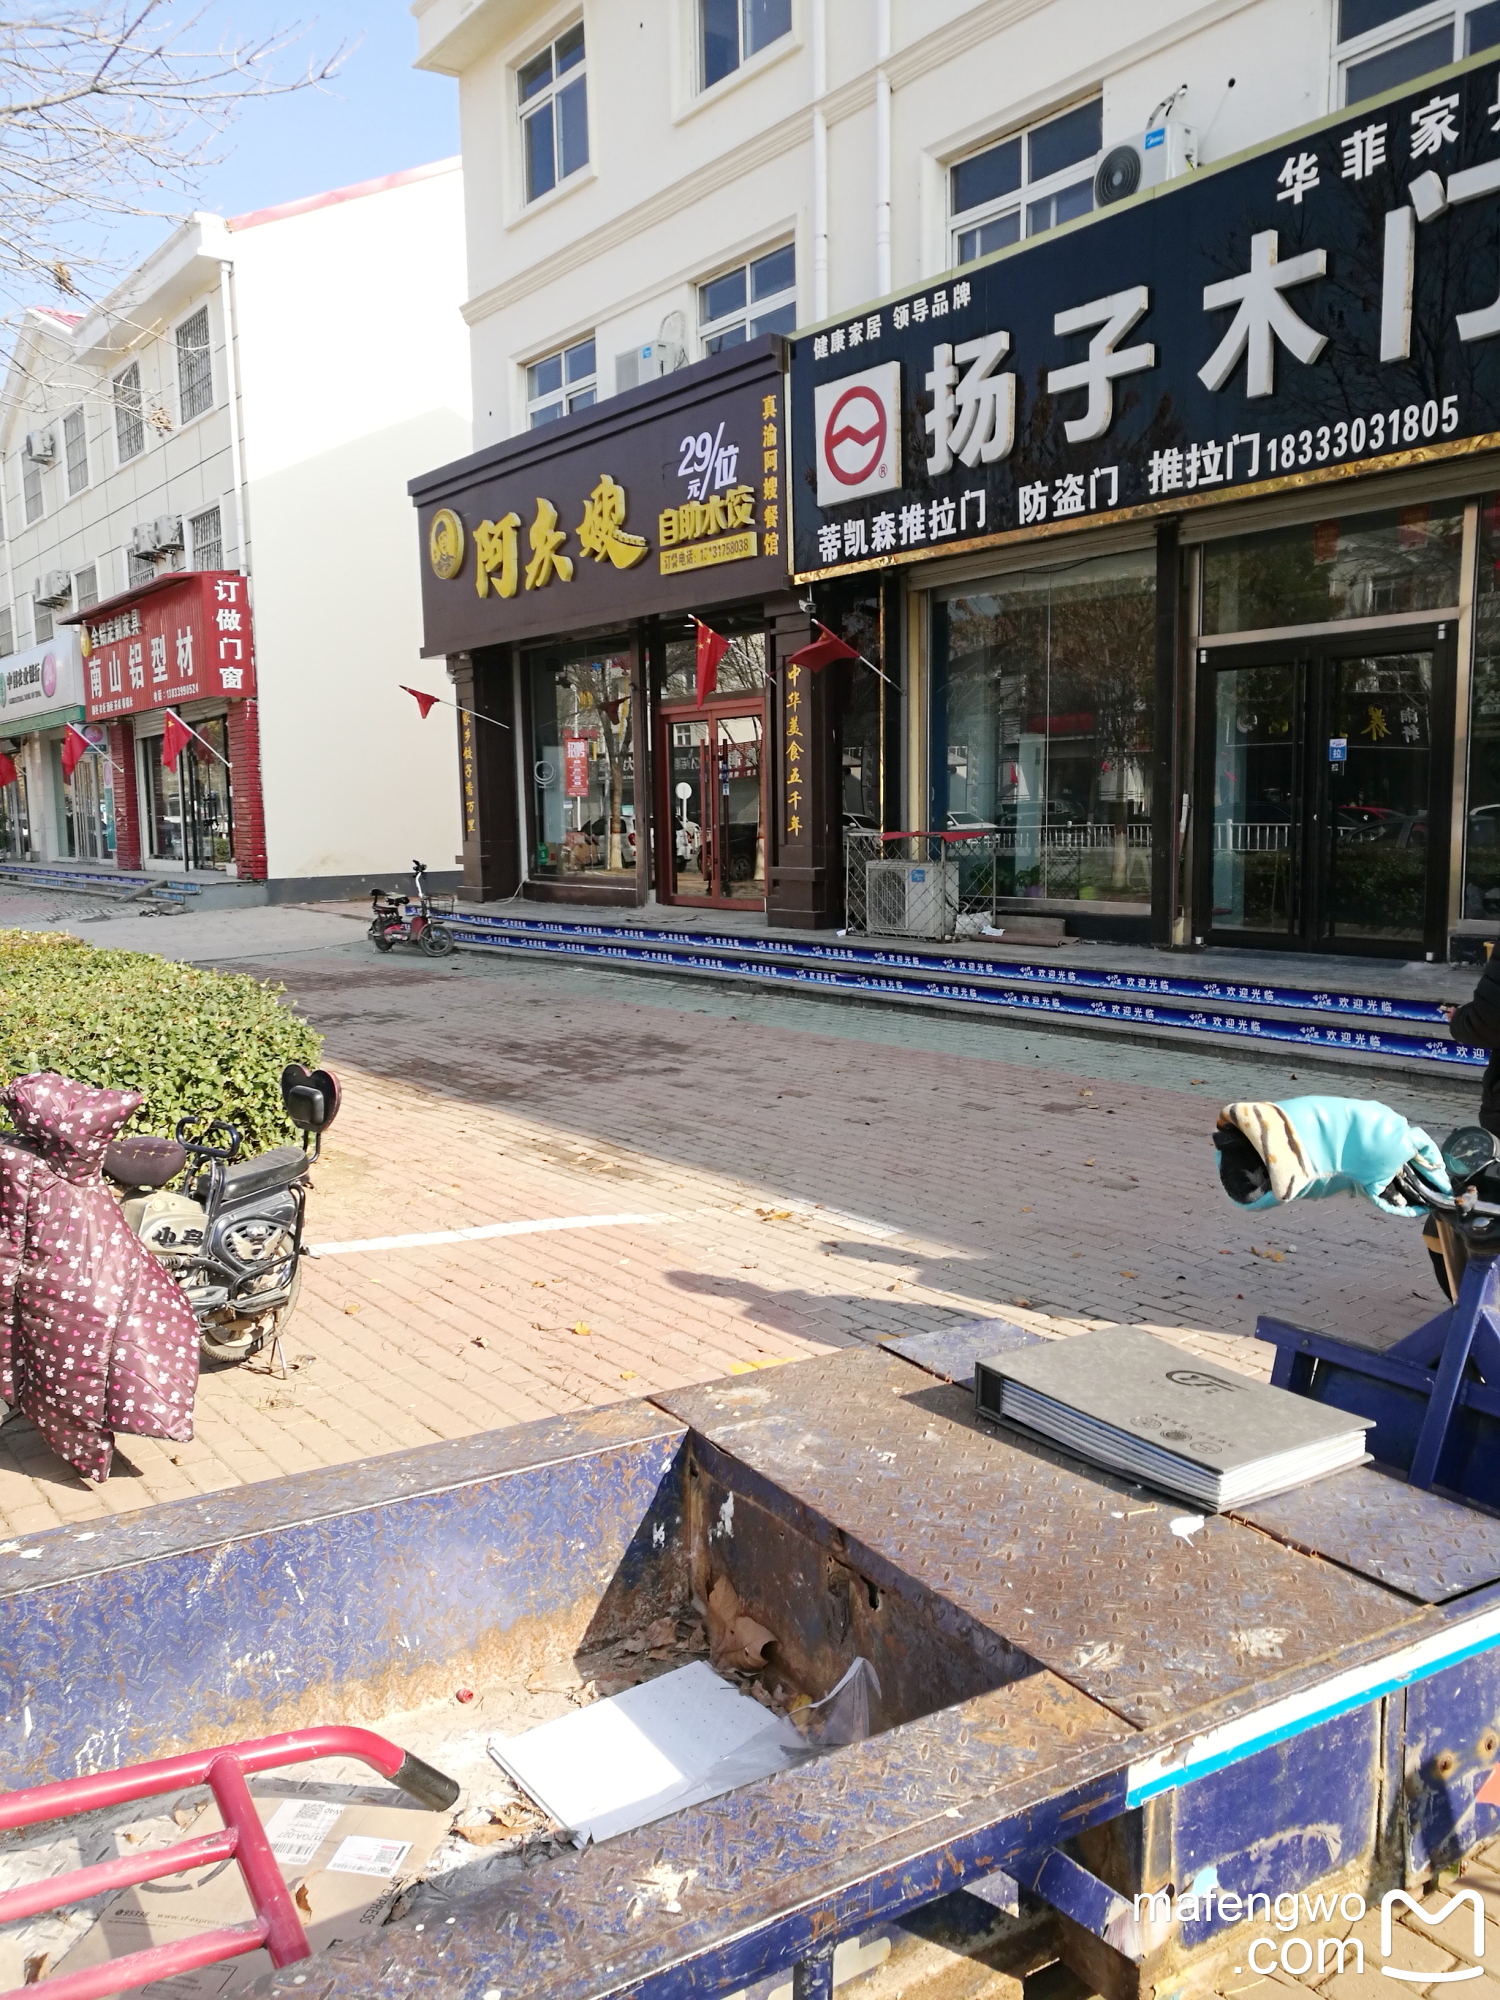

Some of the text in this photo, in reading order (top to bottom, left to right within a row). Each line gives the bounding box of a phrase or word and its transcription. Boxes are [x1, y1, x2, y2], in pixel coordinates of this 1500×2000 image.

[813, 281, 971, 360] 健康家居 领导品牌
[926, 158, 1500, 478] 扬子木门
[1018, 465, 1119, 525] 防盗门
[659, 484, 756, 546] 自助水饺
[817, 489, 986, 562] 蒂凯森推拉门
[214, 579, 244, 690] 订做门窗
[88, 625, 194, 699] 南山铝型材
[786, 664, 804, 837] 中华美食五千年
[1333, 748, 1342, 758] 拉
[1331, 763, 1339, 771] 拉
[716, 938, 740, 947] 欢迎光临
[768, 942, 794, 952] 欢迎光临
[651, 952, 672, 962] 欢迎光临
[826, 948, 854, 958] 欢迎光临
[888, 954, 919, 965] 欢迎光临
[699, 958, 722, 968] 欢迎光临
[752, 964, 777, 975] 欢迎光临
[959, 961, 993, 973] 欢迎光临
[809, 971, 837, 982] 欢迎光临
[1038, 969, 1076, 981] 欢迎光临
[872, 978, 902, 990] 欢迎光临
[1126, 977, 1169, 990] 欢迎光临
[942, 985, 976, 998] 欢迎光临
[1226, 986, 1274, 1001] 欢迎光临
[1021, 994, 1060, 1008] 欢迎光临
[1338, 997, 1392, 1013] 欢迎光临
[1111, 1004, 1154, 1019] 欢迎光临
[1212, 1016, 1260, 1032] 欢迎光临
[1326, 1030, 1380, 1047] 欢迎光临
[359, 1888, 394, 1925] EXPRESS
